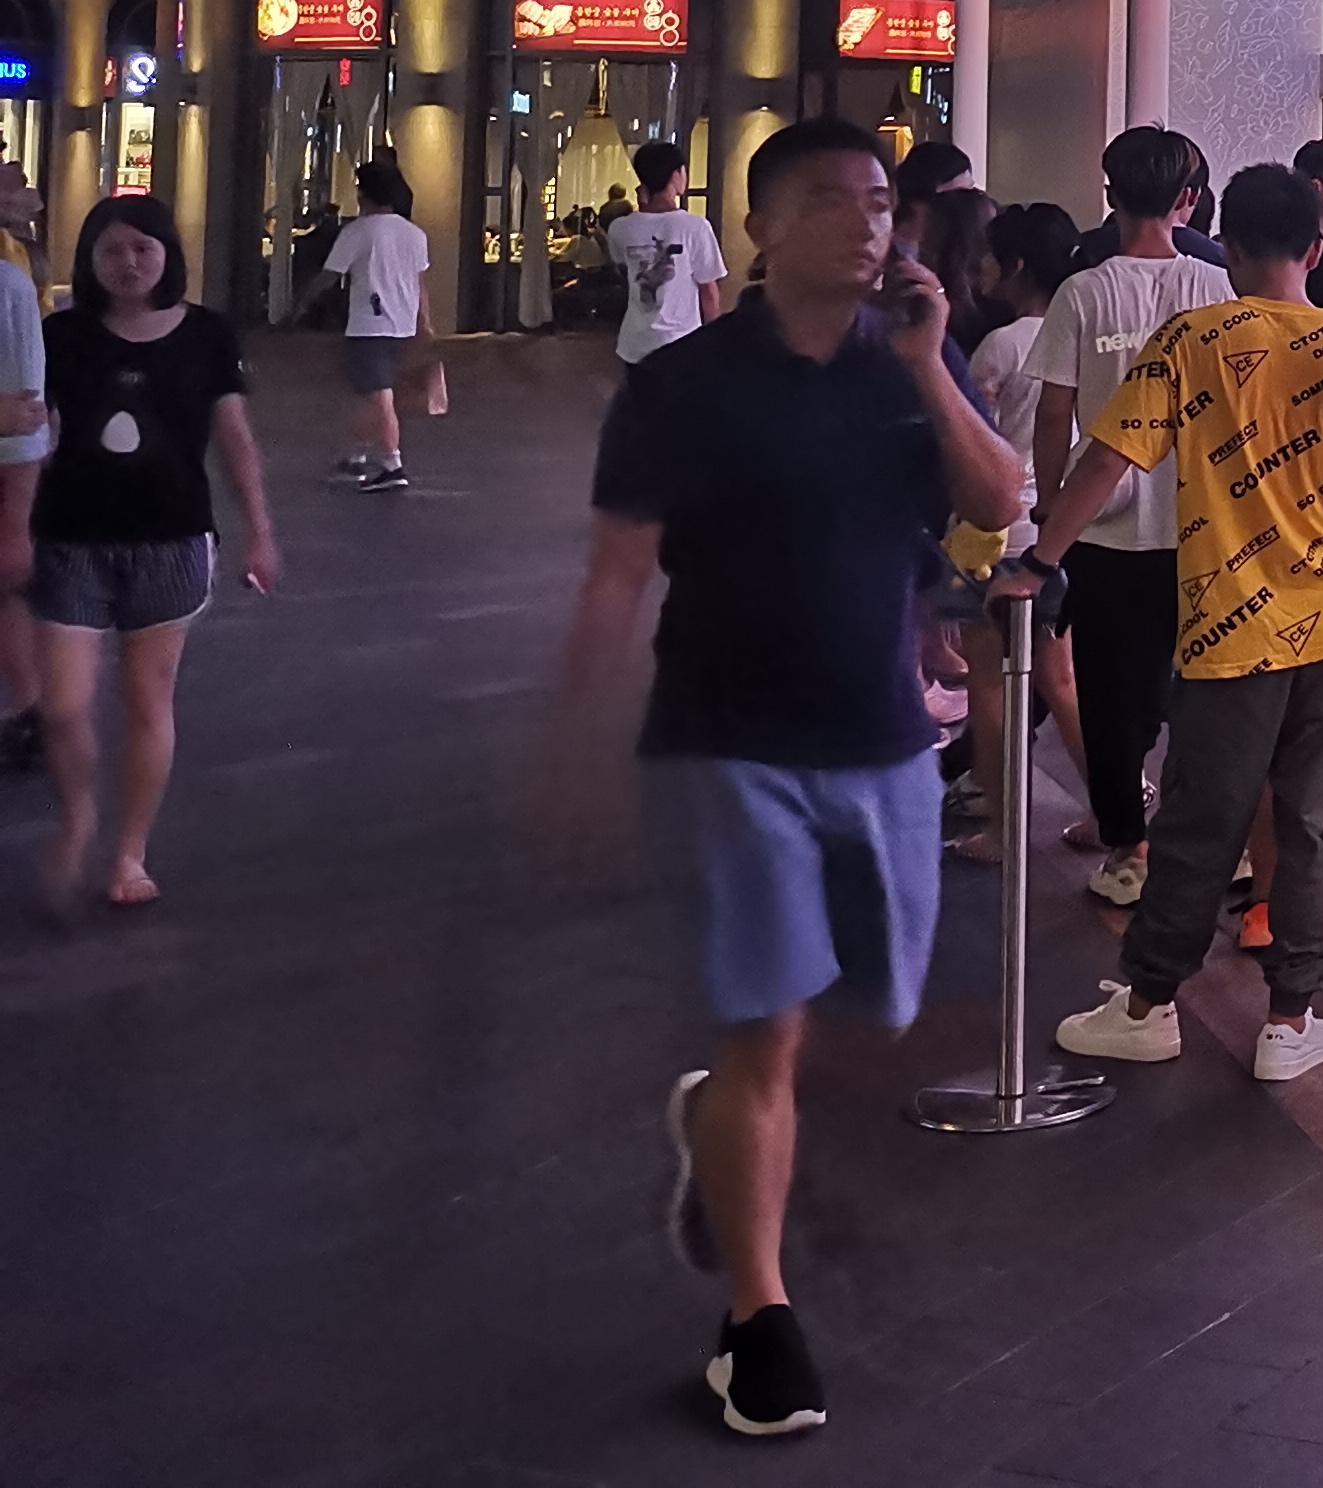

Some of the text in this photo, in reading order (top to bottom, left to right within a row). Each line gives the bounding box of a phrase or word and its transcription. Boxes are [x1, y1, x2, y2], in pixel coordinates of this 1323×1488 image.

[1200, 310, 1261, 346] SO COOL
[1120, 418, 1142, 429] SO
[1230, 429, 1322, 499] COUNTER
[1297, 494, 1316, 512] SO
[1182, 586, 1275, 664] COUNTER
